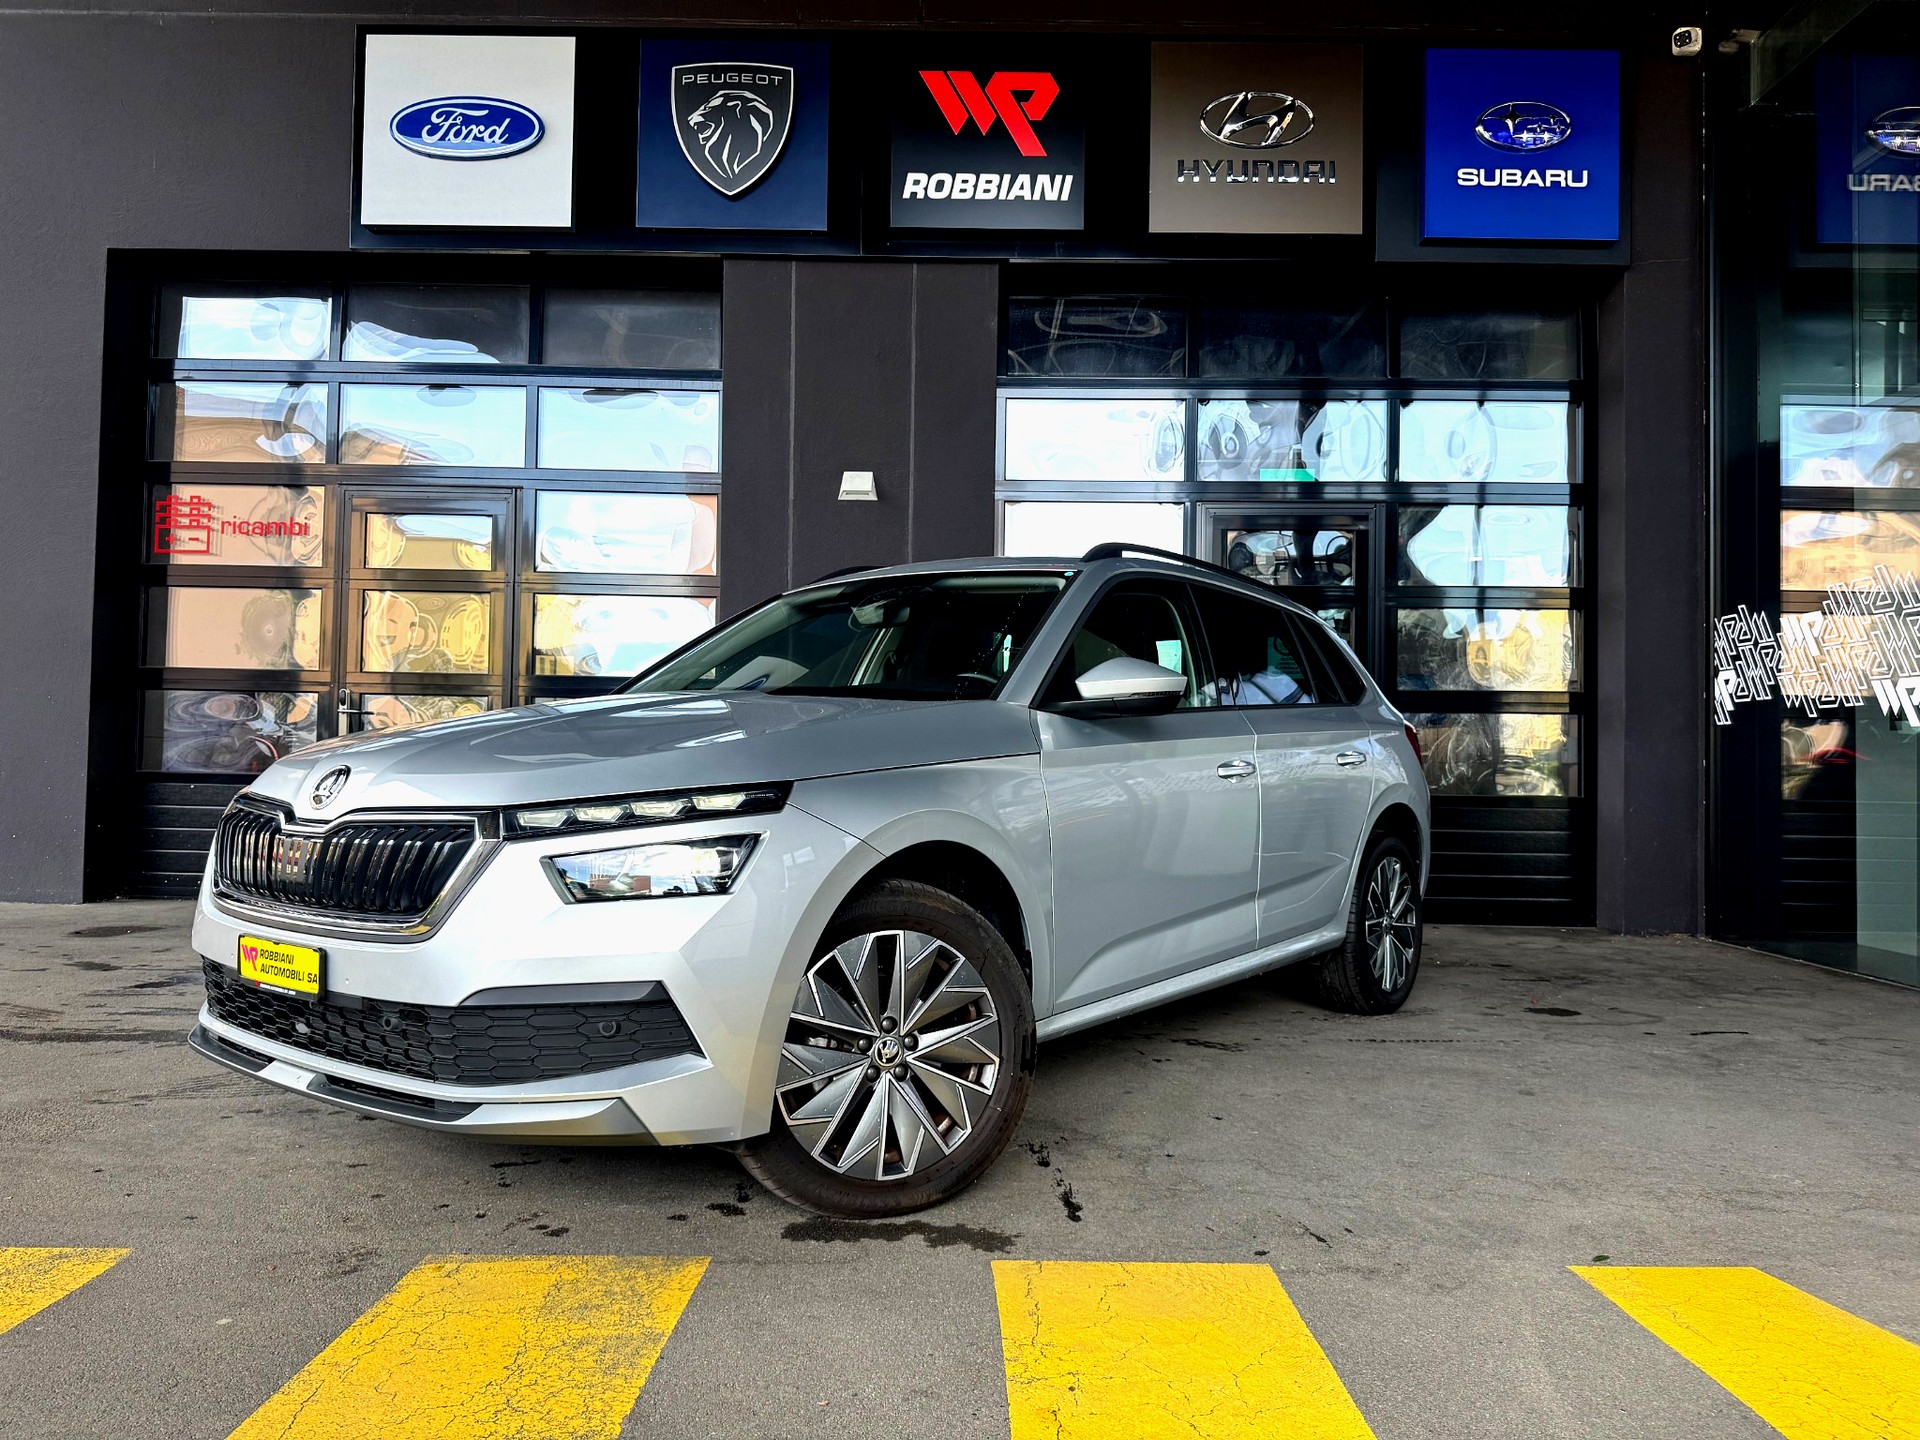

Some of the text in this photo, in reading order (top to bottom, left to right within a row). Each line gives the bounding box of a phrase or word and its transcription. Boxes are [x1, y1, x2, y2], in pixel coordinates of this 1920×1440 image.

[681, 72, 784, 87] PEUGEOT
[421, 107, 509, 146] Ford
[1176, 158, 1337, 185] HYUNDAI
[1456, 168, 1589, 188] SUBARU
[902, 172, 1074, 202] ROBBIANI
[221, 515, 309, 536] ricambi
[260, 949, 294, 965] ROBBIANI
[260, 963, 318, 984] AUTOMOBILI SA
